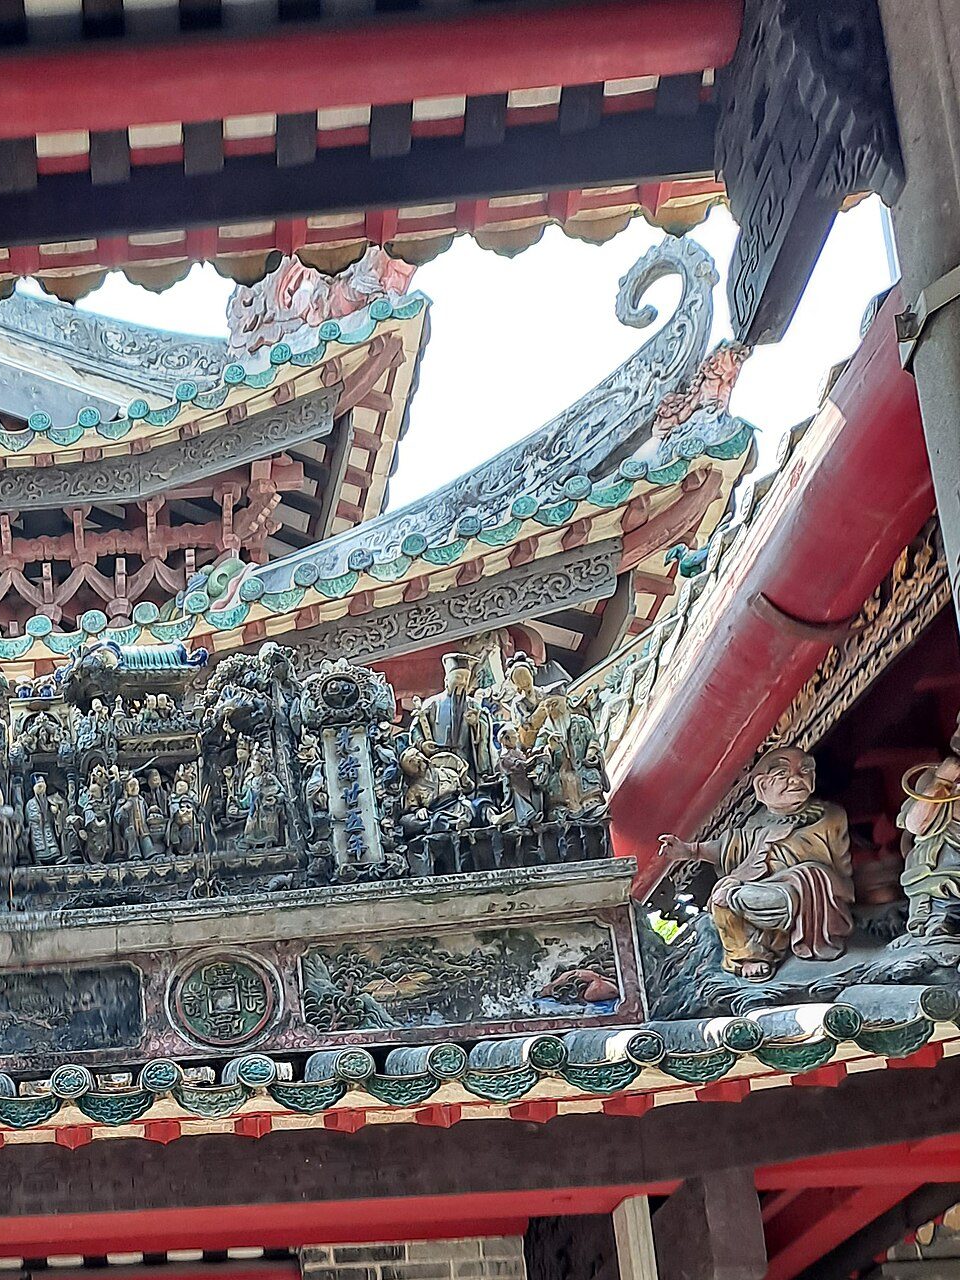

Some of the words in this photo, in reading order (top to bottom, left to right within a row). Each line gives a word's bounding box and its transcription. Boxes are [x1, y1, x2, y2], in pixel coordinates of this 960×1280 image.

[334, 726, 370, 861] 光緒廿五年
